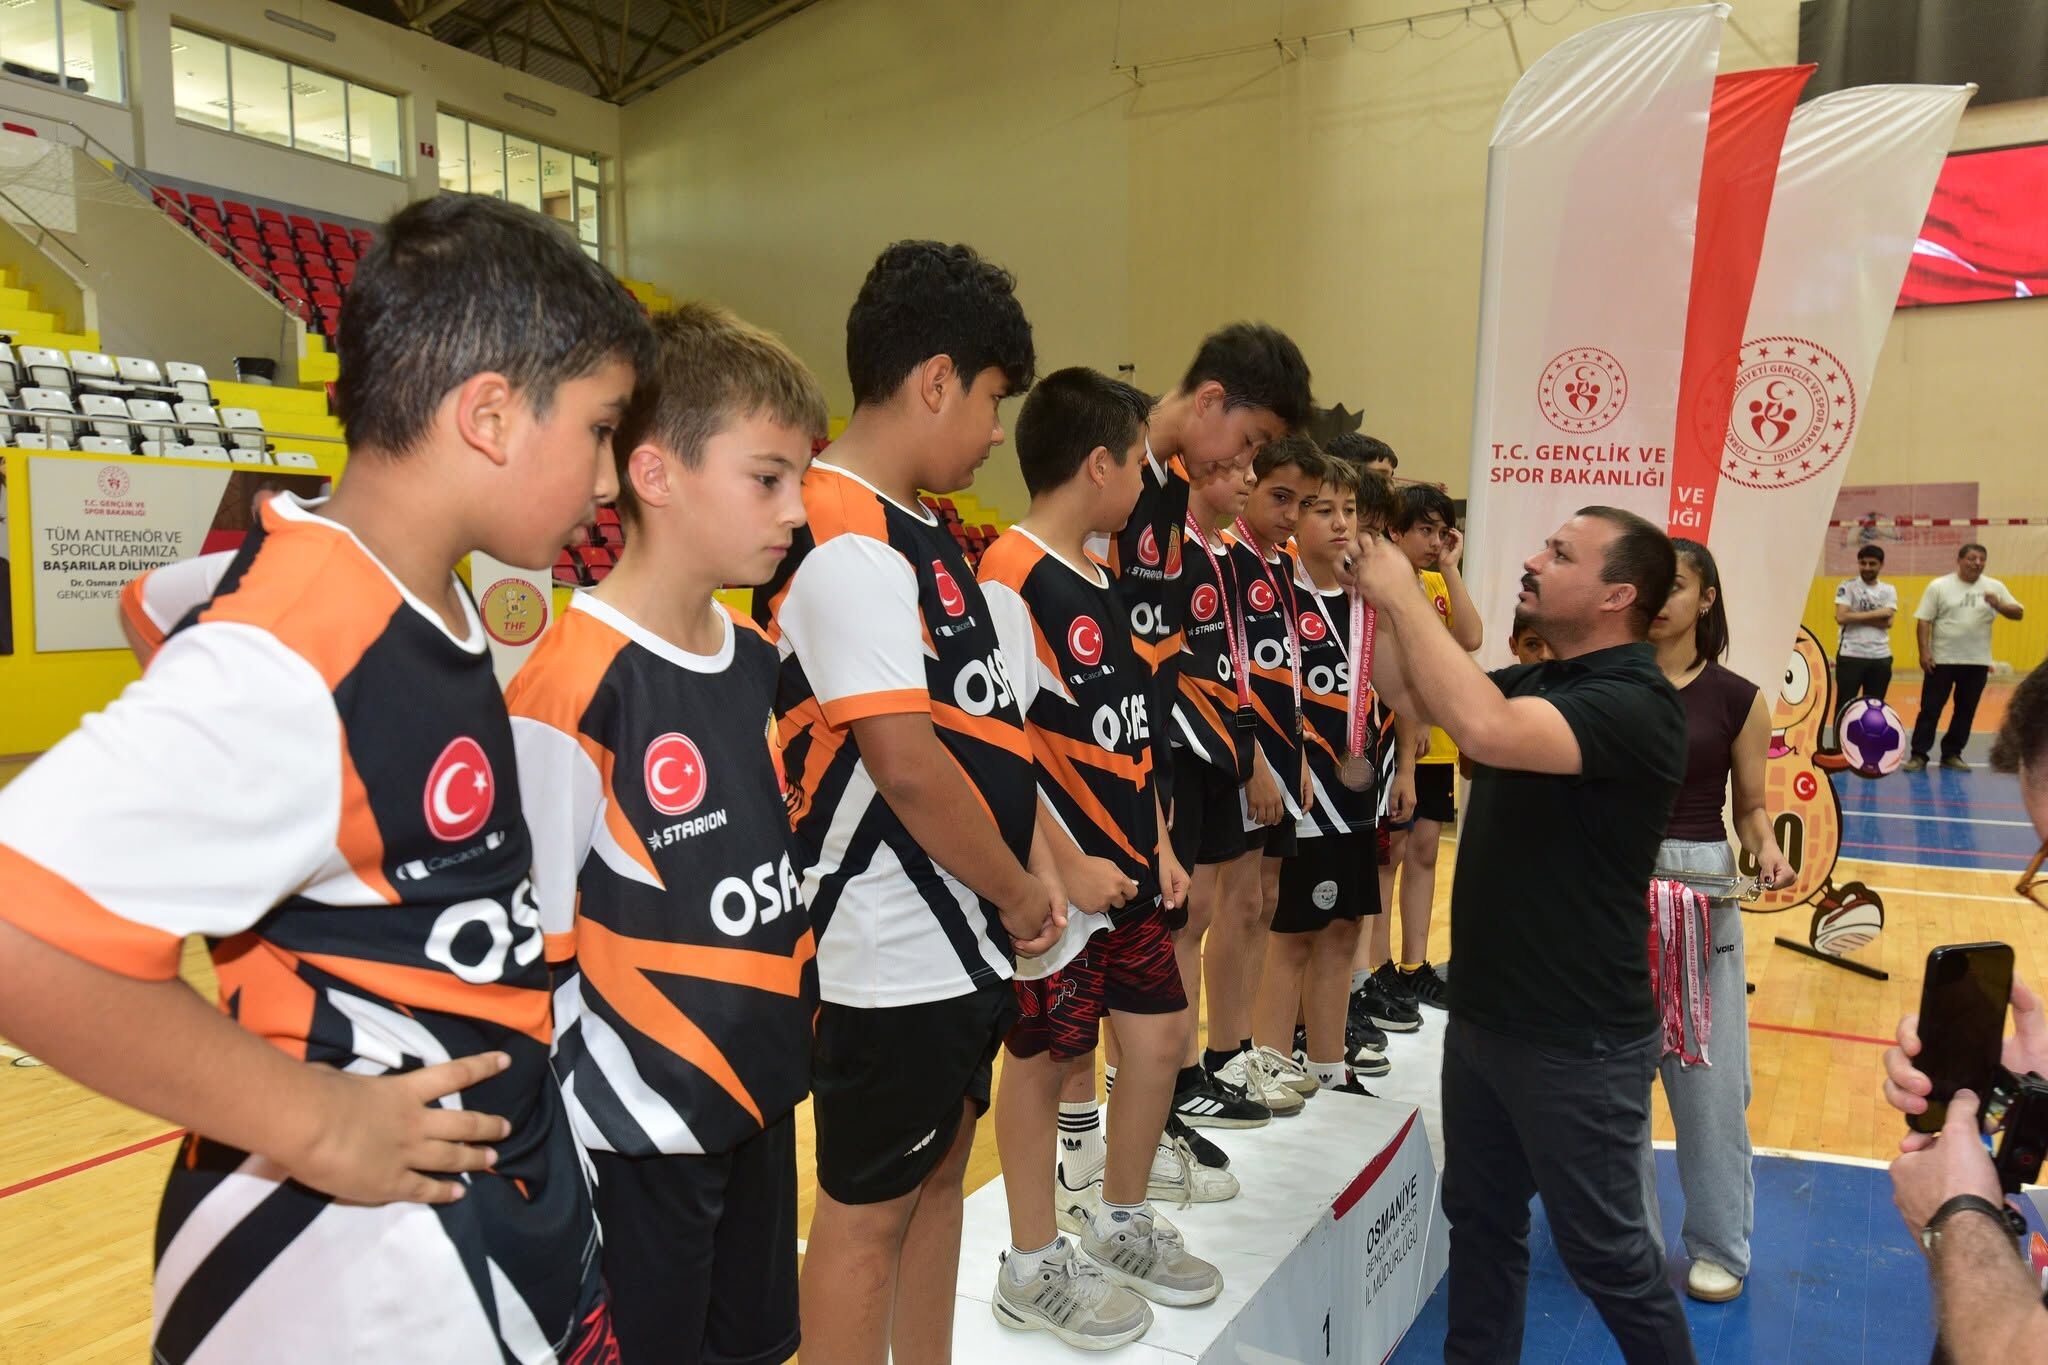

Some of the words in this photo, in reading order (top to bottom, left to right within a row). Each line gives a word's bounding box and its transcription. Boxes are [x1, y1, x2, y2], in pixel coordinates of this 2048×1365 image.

[1734, 365, 1767, 391] URİYETİ
[1770, 365, 1812, 383] GENÇLİK
[1810, 383, 1821, 395] VE
[1815, 397, 1825, 423] SPOR
[1492, 444, 1529, 460] T.C.
[1536, 443, 1630, 465] GENÇLİK
[1639, 447, 1666, 464] VE
[1490, 467, 1544, 484] SPOR
[1550, 468, 1665, 487] BAKANLIĞI
[1677, 486, 1705, 504] VE
[45, 526, 80, 541] TÜM
[84, 528, 162, 543] ANTRENÖR
[165, 531, 183, 543] VE
[51, 544, 178, 557] SPORCULARIMIZA
[43, 560, 115, 573] BAŞARILAR
[70, 579, 84, 587] Dr.
[86, 579, 118, 587] Osman
[57, 590, 99, 601] GENÇLİK
[101, 590, 113, 599] VE
[504, 622, 526, 631] THF
[662, 808, 728, 846] STARION
[1716, 944, 1735, 954] VOID
[1367, 1174, 1417, 1254] OSMANİYE
[1322, 1307, 1331, 1358] 1
